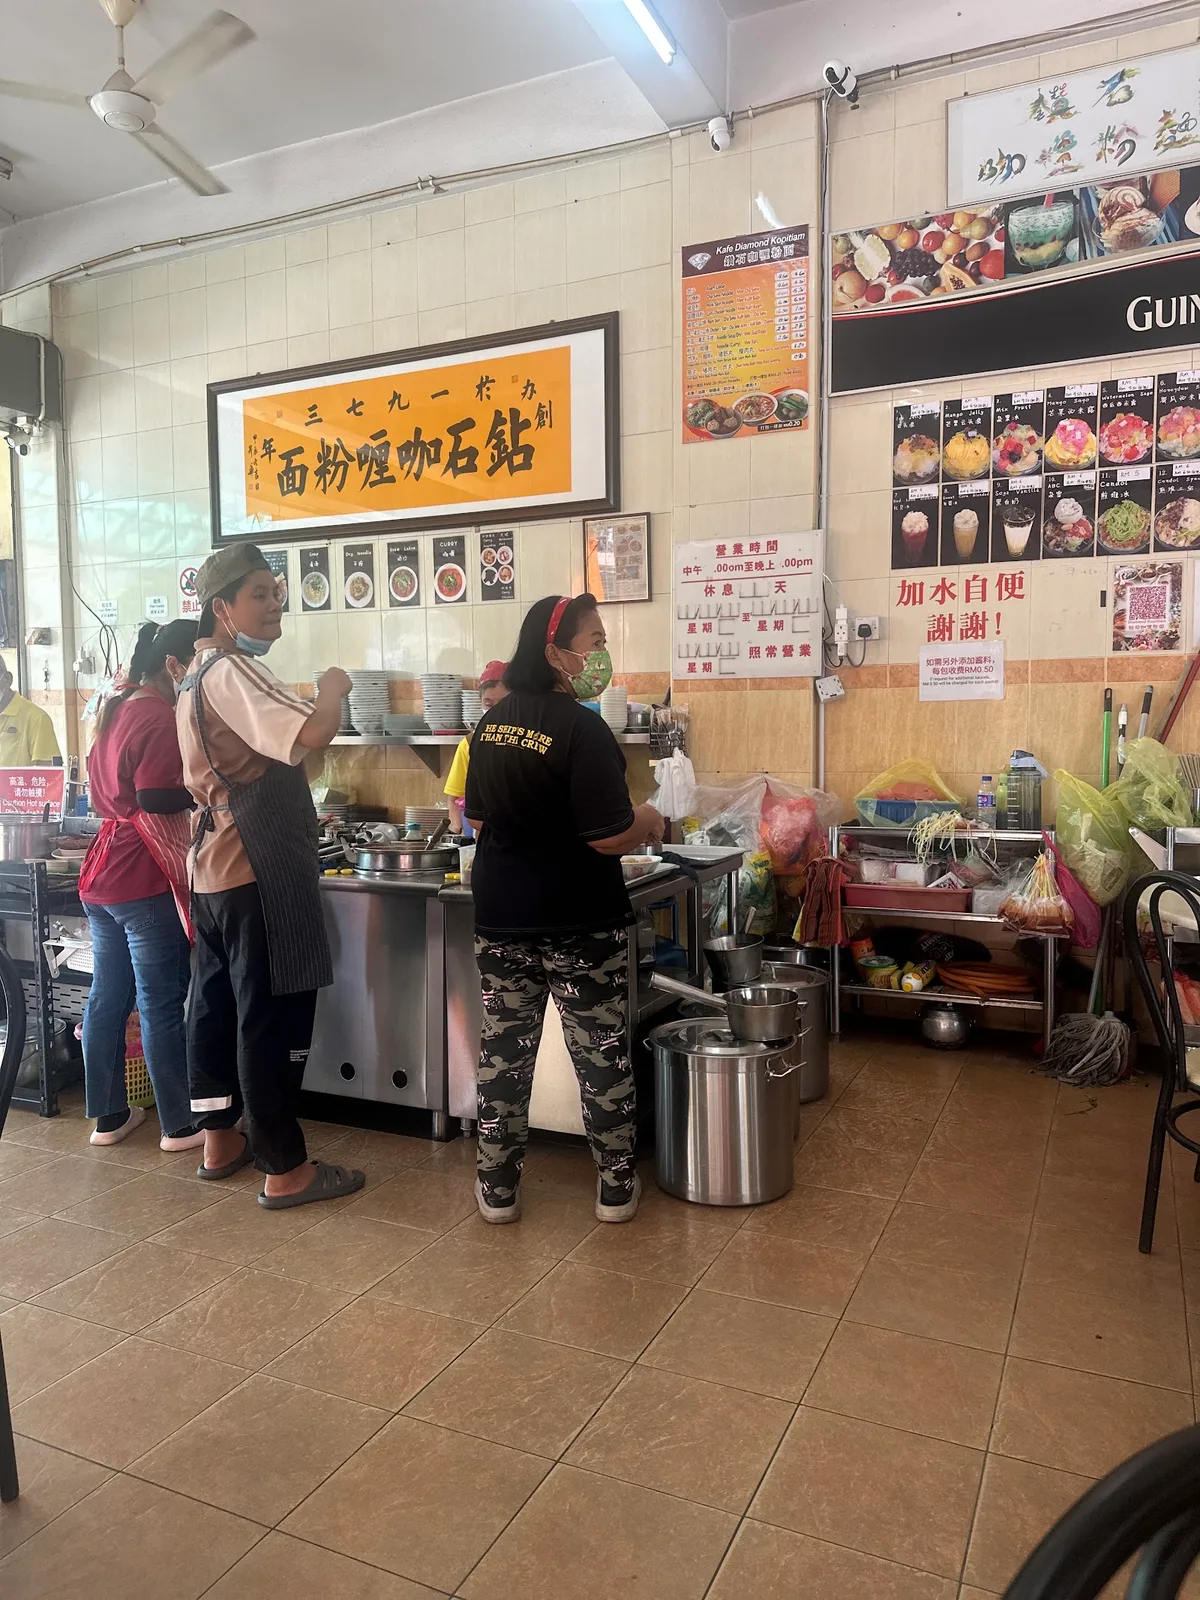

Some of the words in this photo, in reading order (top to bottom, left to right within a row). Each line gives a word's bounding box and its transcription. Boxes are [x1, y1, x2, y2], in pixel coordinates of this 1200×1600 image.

[716, 245, 733, 254] Kafe
[735, 239, 769, 251] Diamond
[771, 232, 805, 244] Kopitiam
[945, 412, 964, 420] Mango
[1100, 480, 1128, 488] Cendol
[716, 540, 778, 556] 營業時間
[682, 566, 702, 576] 中午
[704, 583, 734, 598] 休息
[774, 580, 786, 594] 天
[896, 570, 1025, 607] 加水自便
[182, 600, 201, 613] 禁止
[687, 622, 712, 634] 星期
[742, 612, 750, 622] 至
[757, 620, 784, 632] 星期
[687, 662, 712, 673] 星期
[748, 644, 812, 658] 照常營業
[2, 798, 26, 806] Caution
